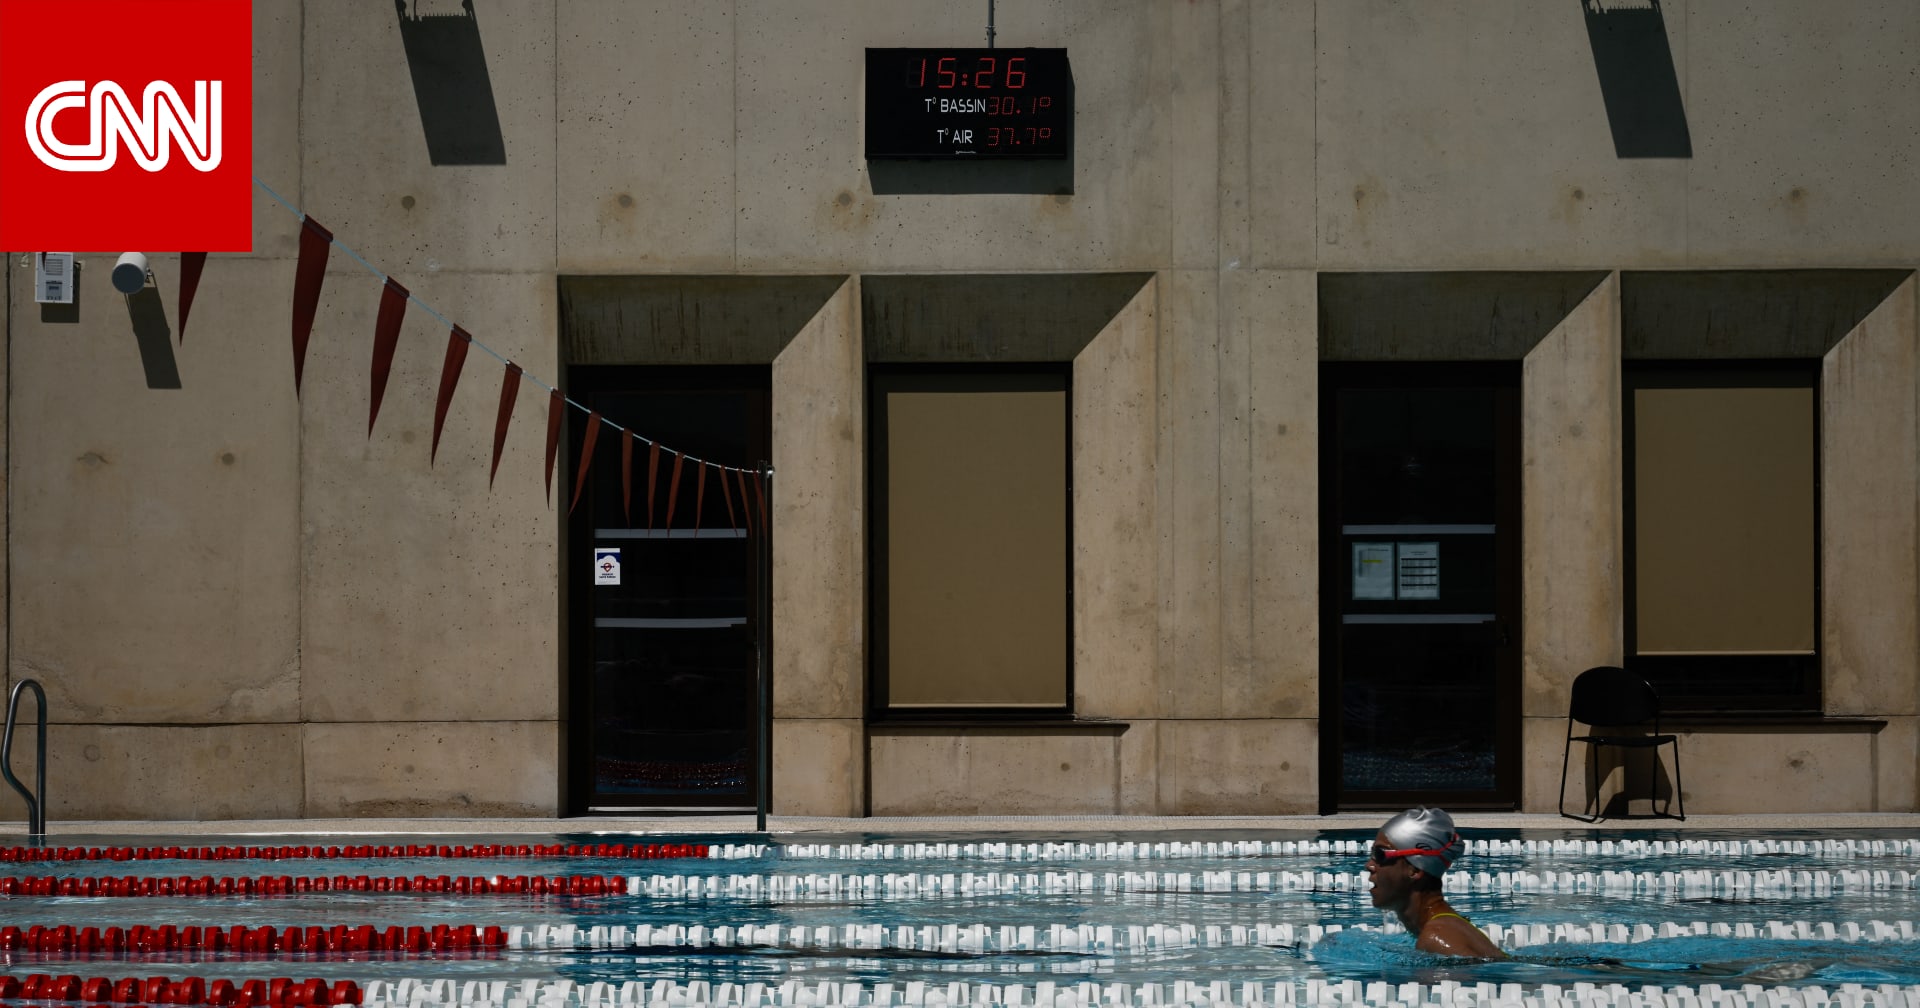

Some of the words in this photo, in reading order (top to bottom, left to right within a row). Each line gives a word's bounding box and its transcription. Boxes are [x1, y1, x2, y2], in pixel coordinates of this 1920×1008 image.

[920, 57, 1026, 88] 15:26
[940, 98, 986, 113] BASSIN
[952, 129, 973, 144] AIR
